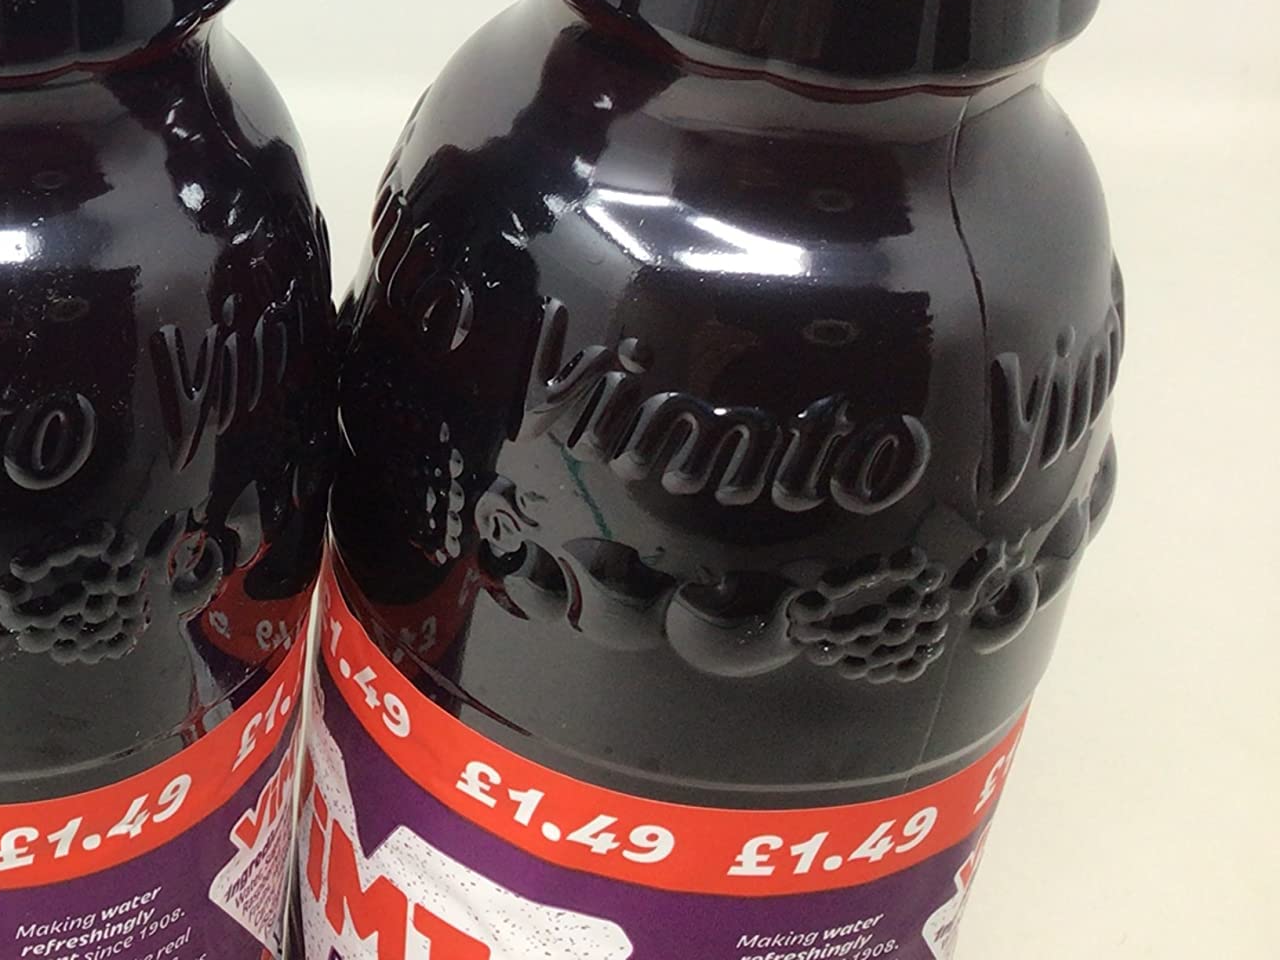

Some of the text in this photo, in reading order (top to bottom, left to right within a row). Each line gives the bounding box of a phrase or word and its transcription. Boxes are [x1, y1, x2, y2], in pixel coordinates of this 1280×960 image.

[526, 294, 933, 515] Vimto
[455, 760, 676, 863] £1.49
[727, 806, 939, 878] £1.49
[16, 885, 162, 940] Making water
[20, 907, 156, 957] refreshingly
[83, 910, 186, 960] since 1908.
[736, 912, 884, 949] Making water
[156, 927, 192, 960] real
